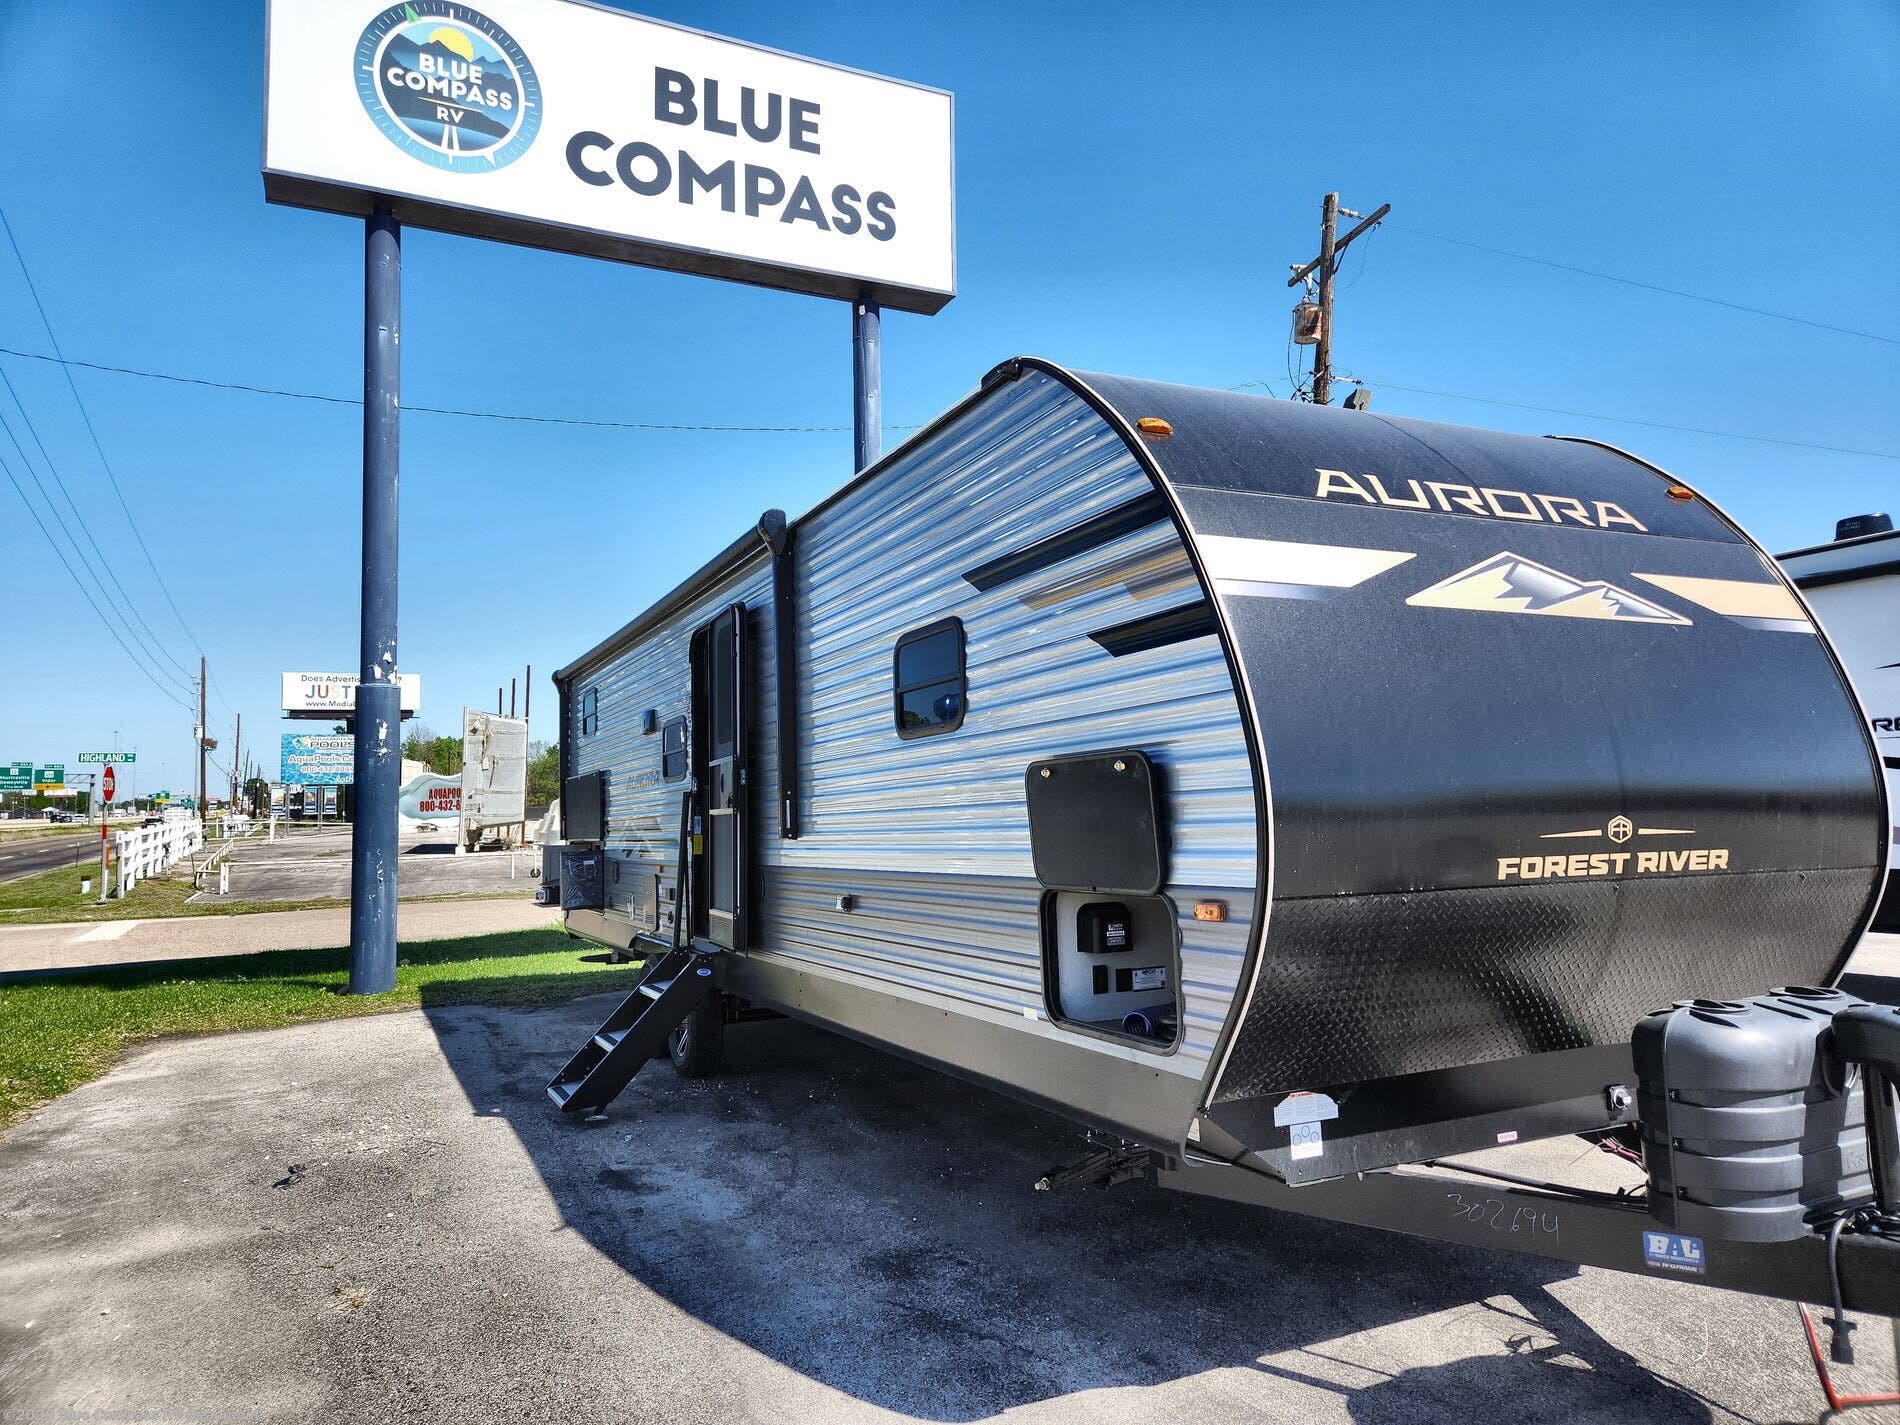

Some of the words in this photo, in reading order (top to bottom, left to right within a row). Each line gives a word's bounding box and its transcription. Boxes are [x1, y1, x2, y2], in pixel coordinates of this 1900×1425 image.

[419, 53, 483, 85] BLUE
[387, 67, 513, 111] COMPASS
[436, 106, 464, 123] RV
[654, 66, 820, 155] BLUE
[565, 131, 897, 241] COMPASS
[1314, 468, 1649, 532] AURORA
[301, 674, 323, 682] Does
[305, 684, 351, 699] JUST
[80, 753, 125, 762] HIGHLAND
[103, 777, 114, 791] STOP
[1497, 852, 1631, 880] FOREST
[1636, 849, 1729, 873] RIVER
[1648, 1234, 1700, 1259] BAL
